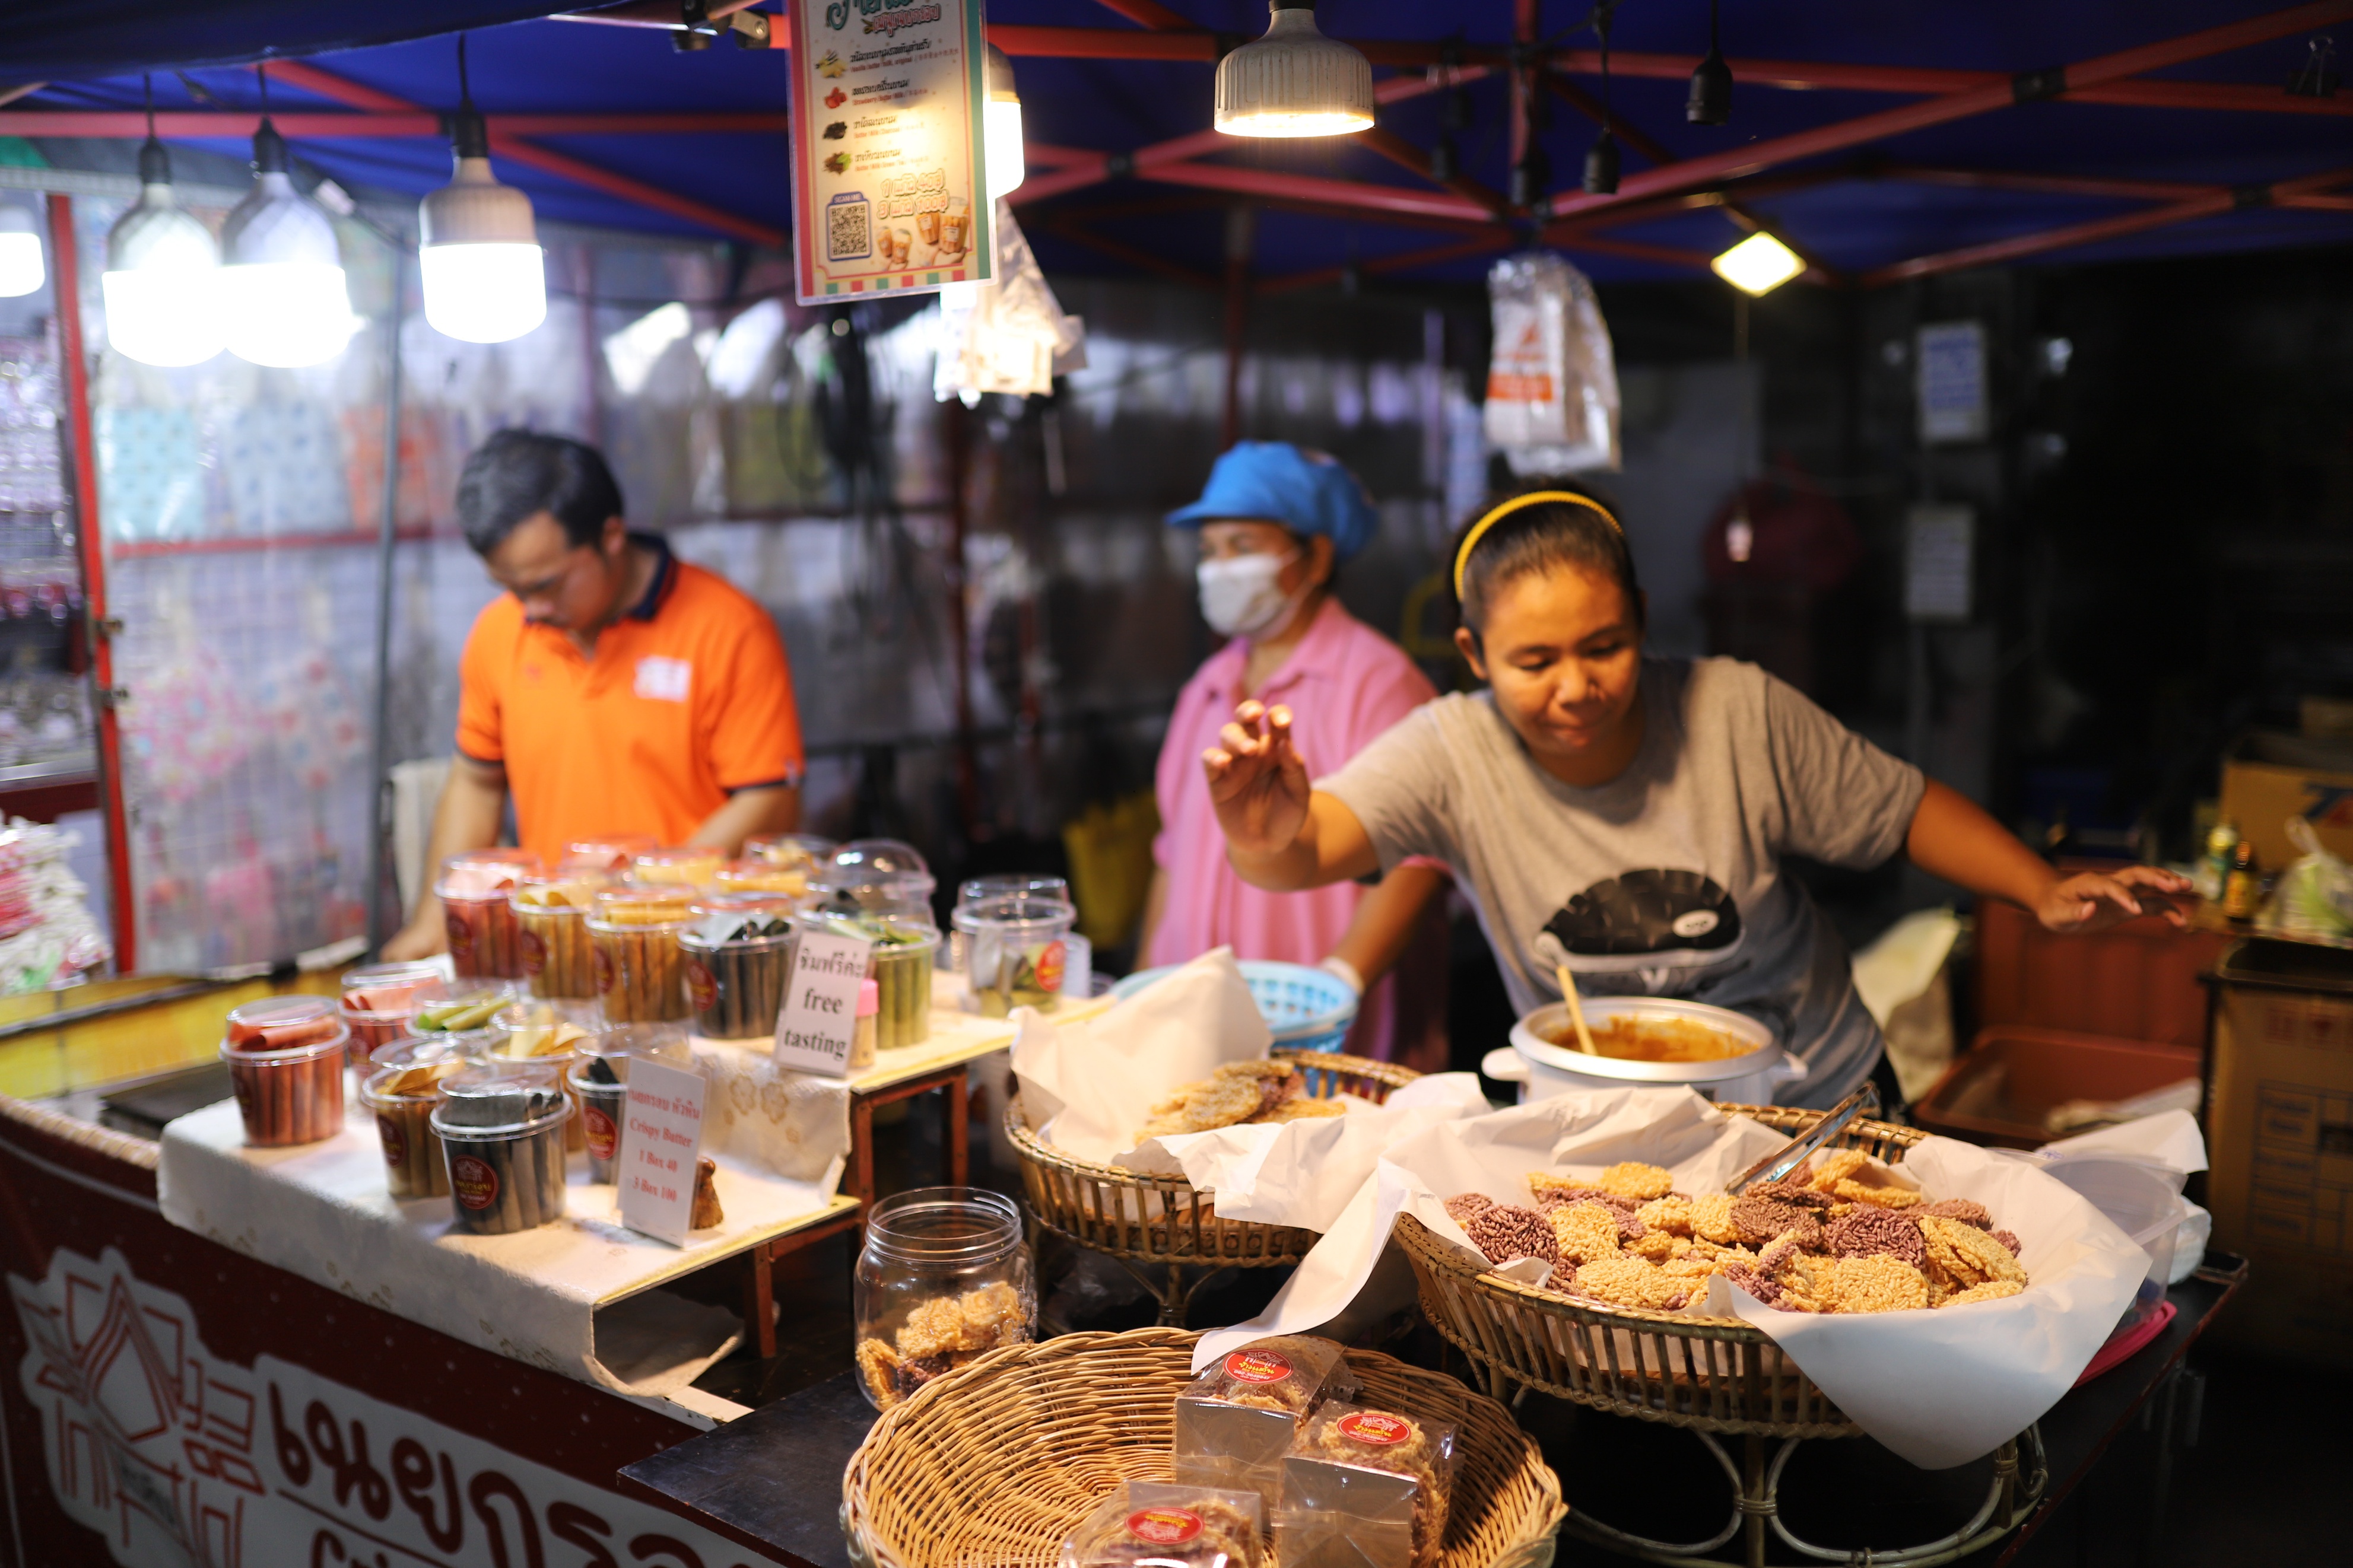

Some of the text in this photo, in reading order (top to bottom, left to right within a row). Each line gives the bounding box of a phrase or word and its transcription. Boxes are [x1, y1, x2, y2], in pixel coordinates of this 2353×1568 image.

[878, 201, 889, 220] 3
[804, 988, 843, 1014] free
[785, 1029, 847, 1061] tasting
[630, 1117, 693, 1148] Crispy Butter
[647, 1151, 664, 1169] Box
[633, 1176, 639, 1189] 3
[641, 1178, 658, 1197] Box
[268, 1380, 754, 1568] เนยกร
